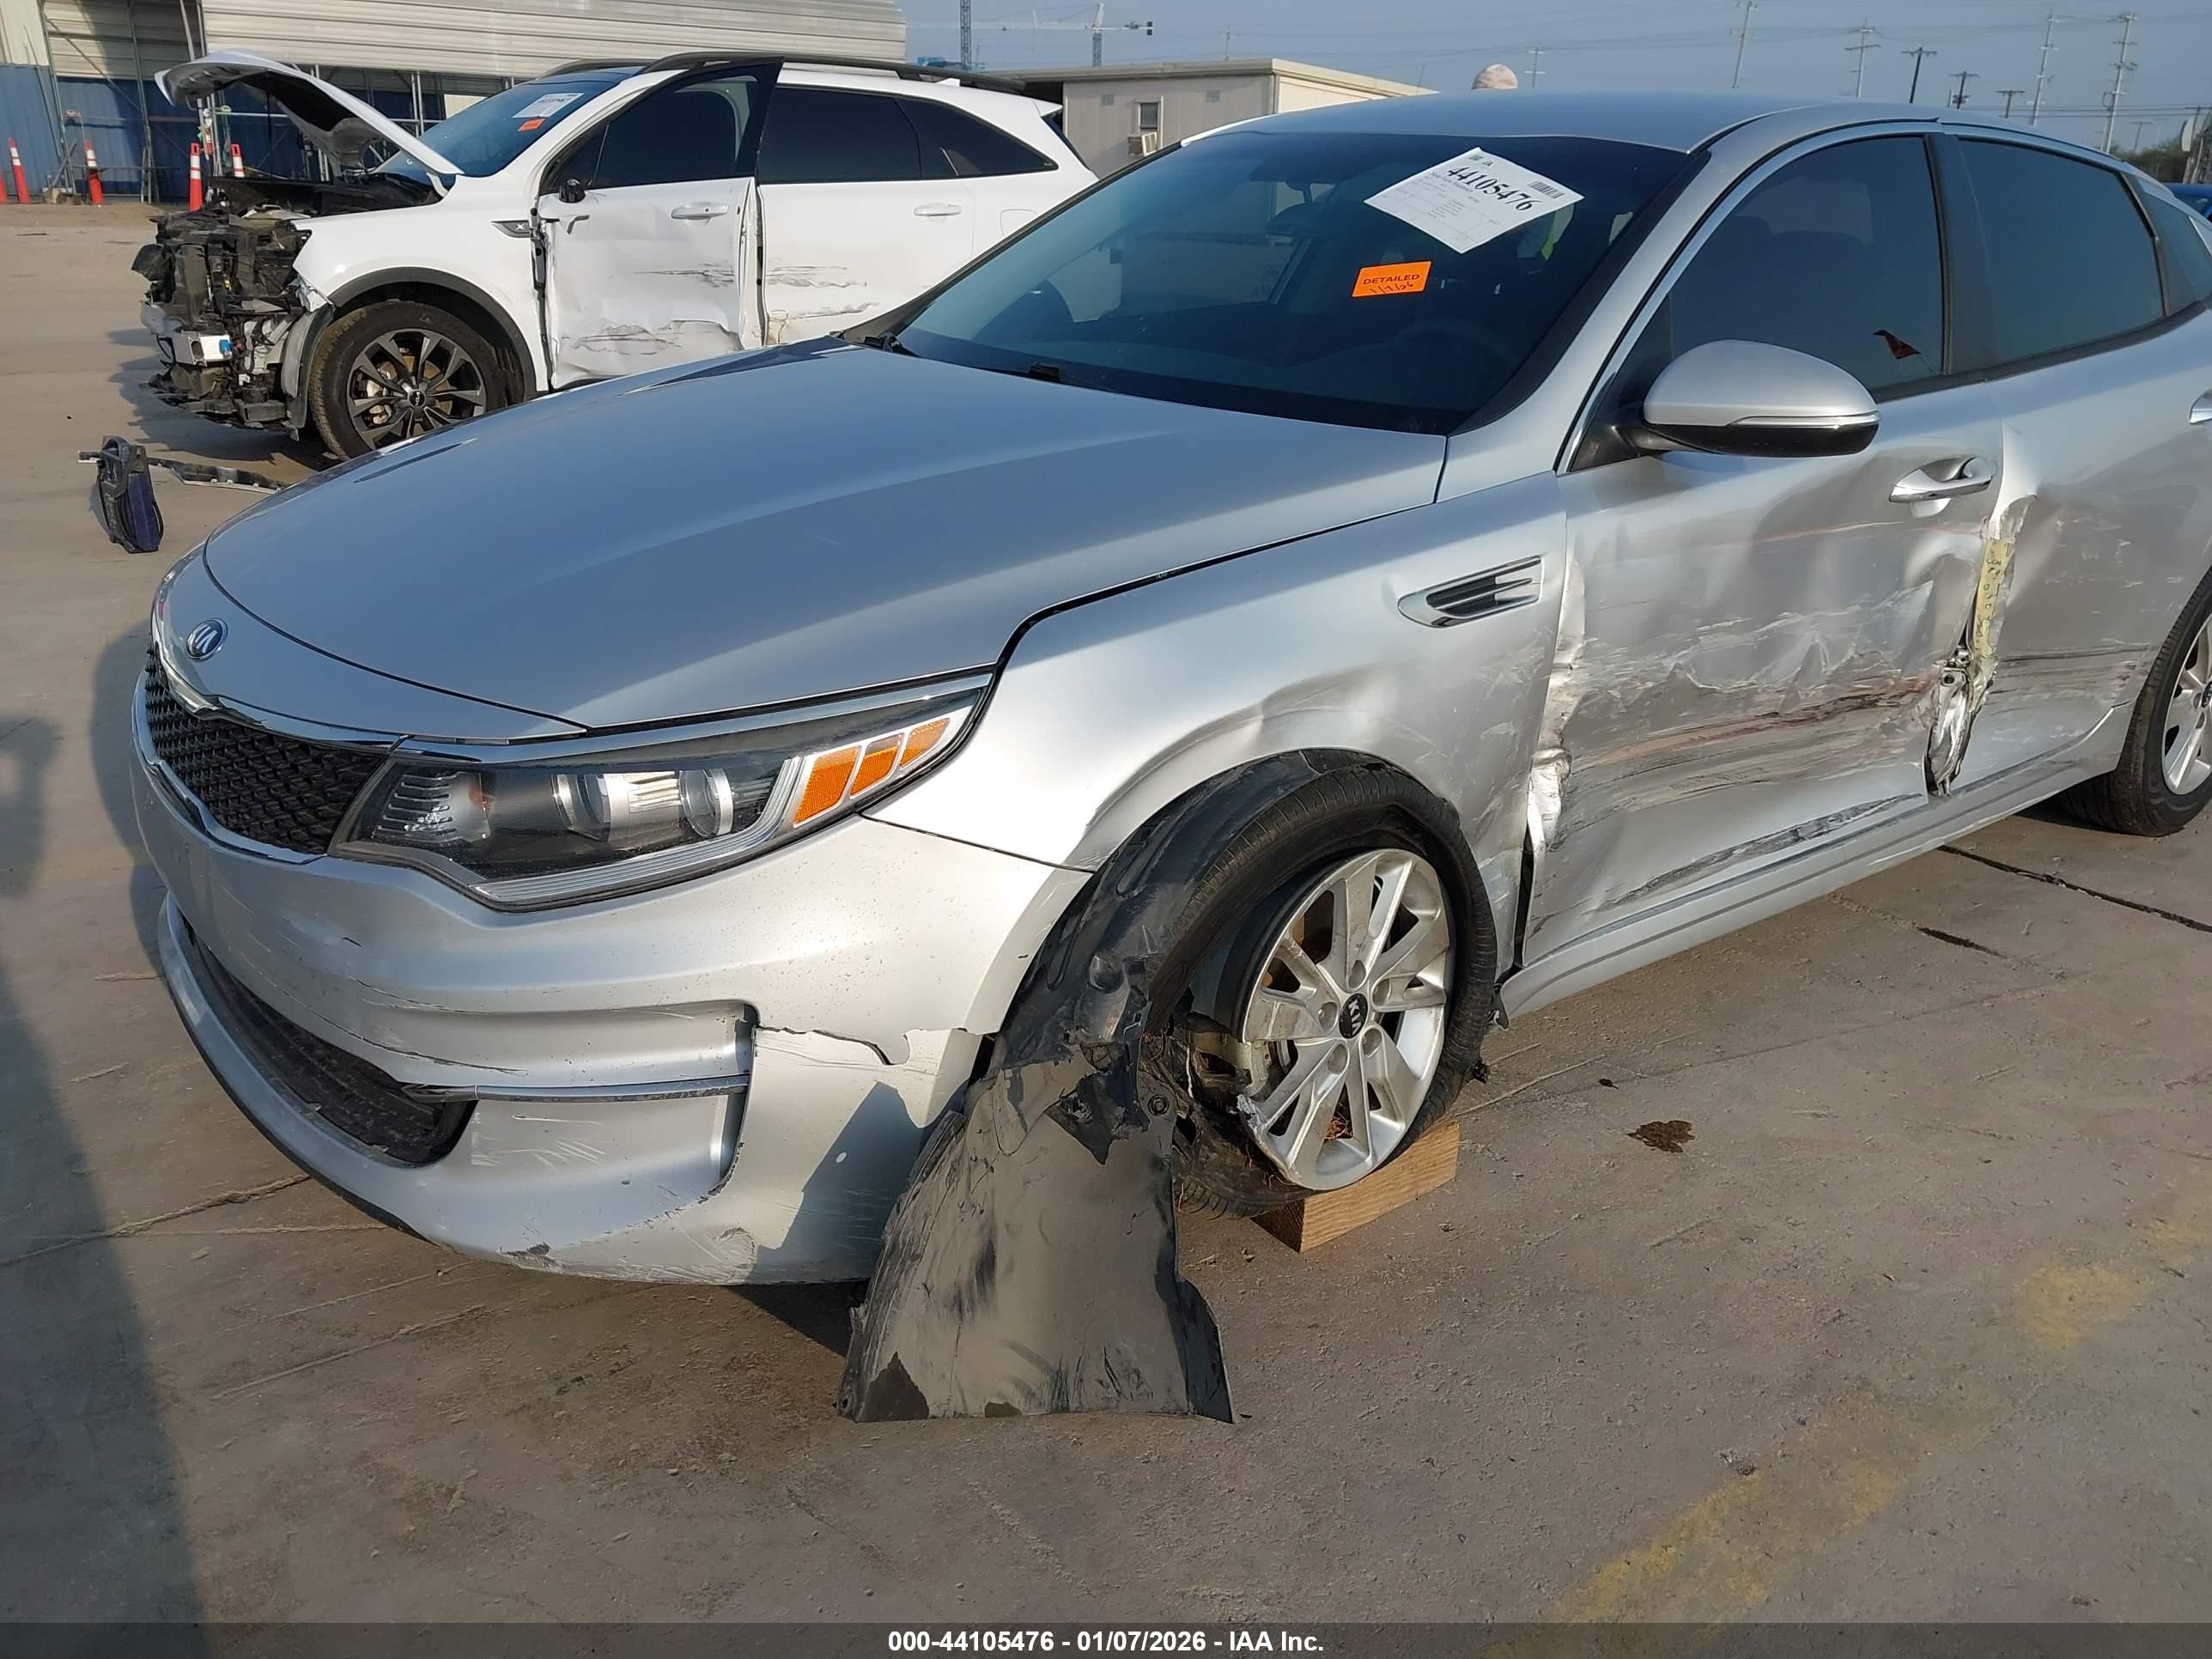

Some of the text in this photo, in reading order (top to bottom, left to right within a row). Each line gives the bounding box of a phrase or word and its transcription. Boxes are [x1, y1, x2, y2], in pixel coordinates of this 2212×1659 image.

[1447, 167, 1543, 211] 44105476
[1363, 274, 1420, 285] DETAILED
[1347, 997, 1362, 1036] KIA
